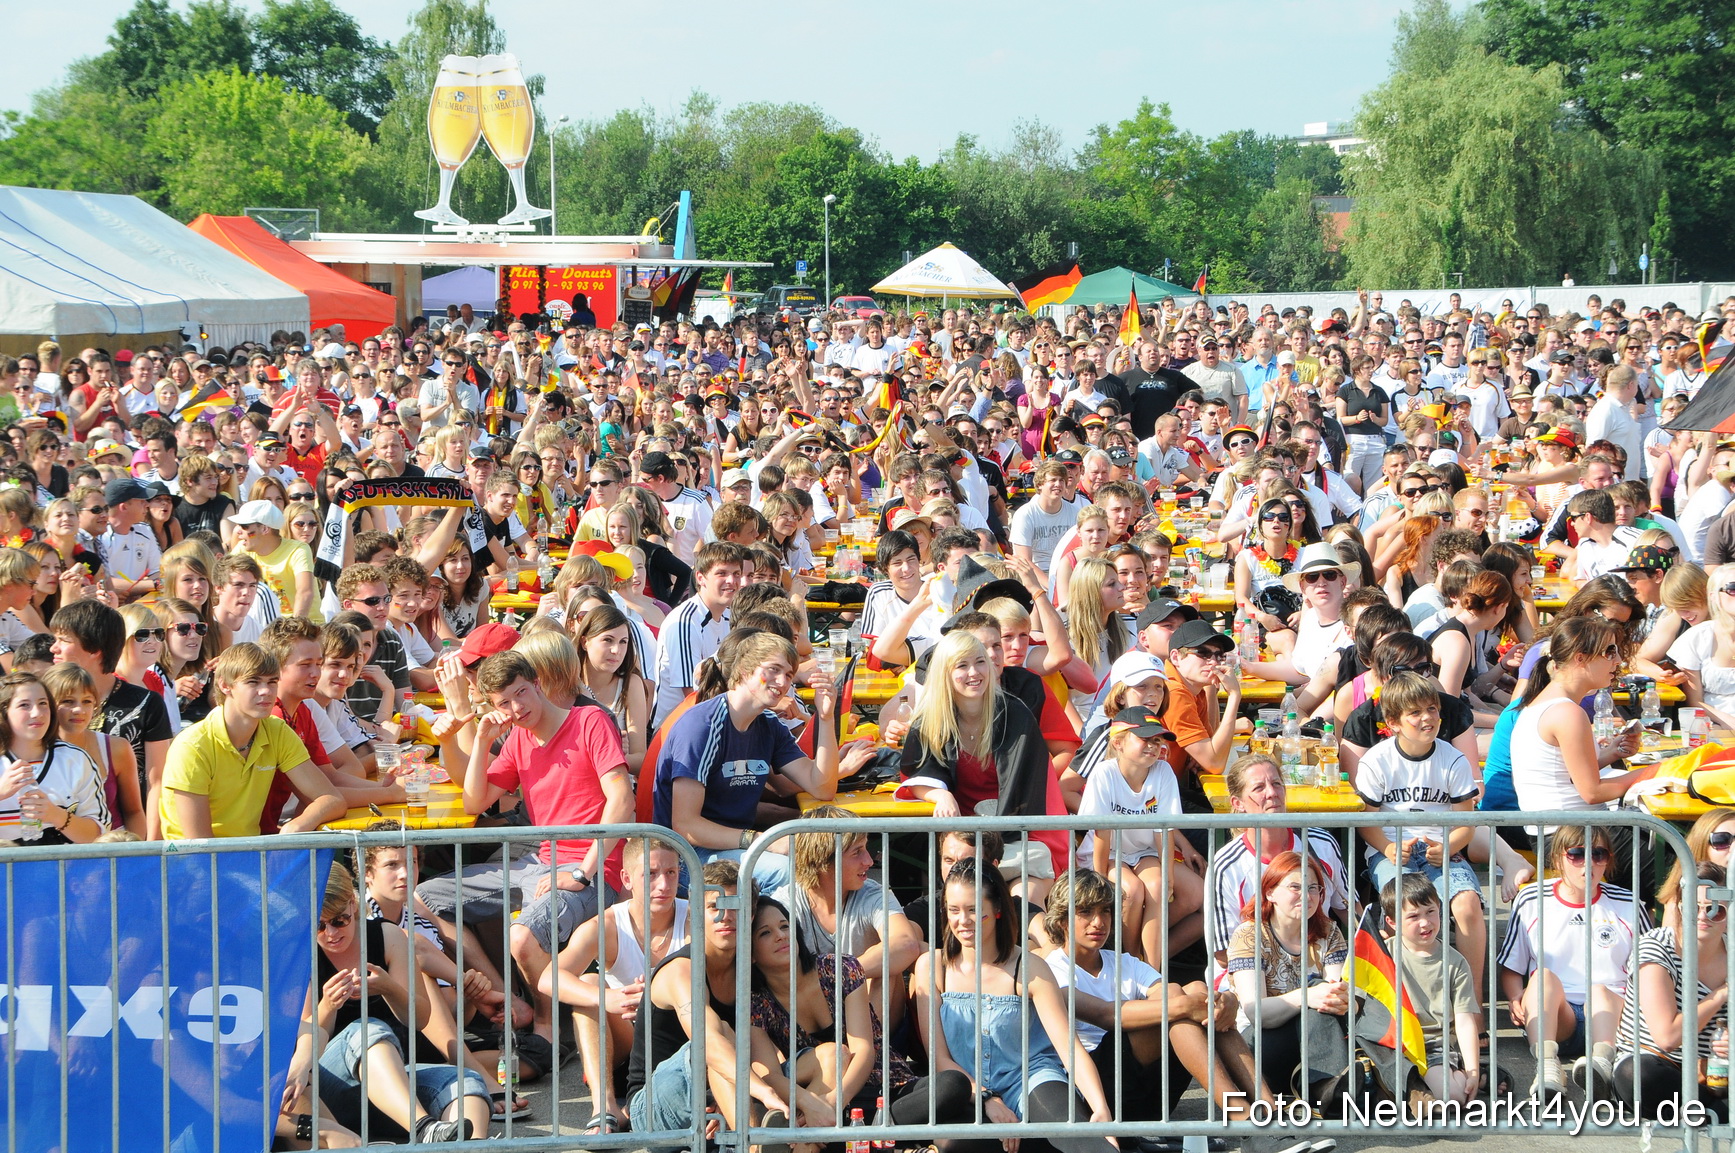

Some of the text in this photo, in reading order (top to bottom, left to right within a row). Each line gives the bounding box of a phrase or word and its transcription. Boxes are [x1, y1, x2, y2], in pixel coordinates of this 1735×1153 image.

[509, 266, 540, 278] Min
[562, 267, 612, 279] Donuts
[561, 281, 573, 290] 93
[577, 281, 589, 290] 93
[592, 281, 604, 290] 96
[339, 481, 474, 504] DEUTSCHLAND
